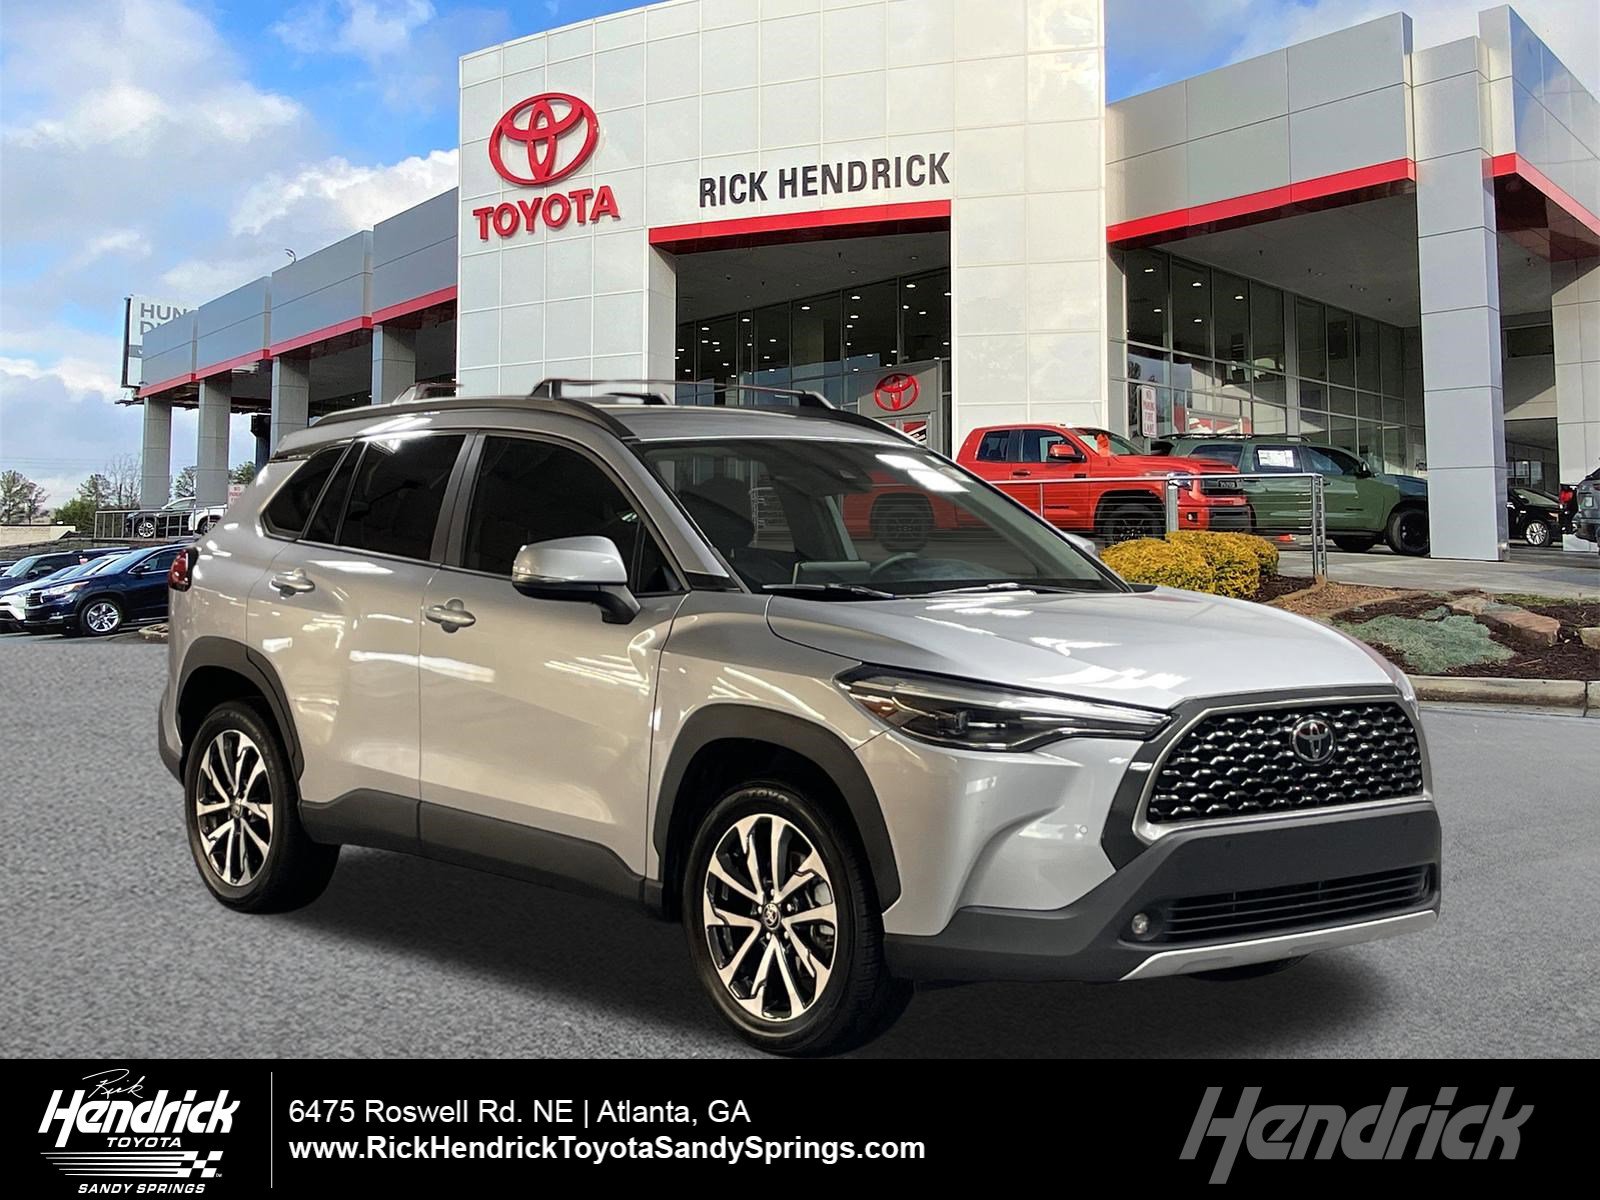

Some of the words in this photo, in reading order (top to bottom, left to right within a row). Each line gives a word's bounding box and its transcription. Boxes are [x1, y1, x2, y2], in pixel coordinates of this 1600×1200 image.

[699, 170, 768, 208] RICK
[779, 152, 951, 199] HENDRICK
[473, 185, 620, 240] TOYOTA
